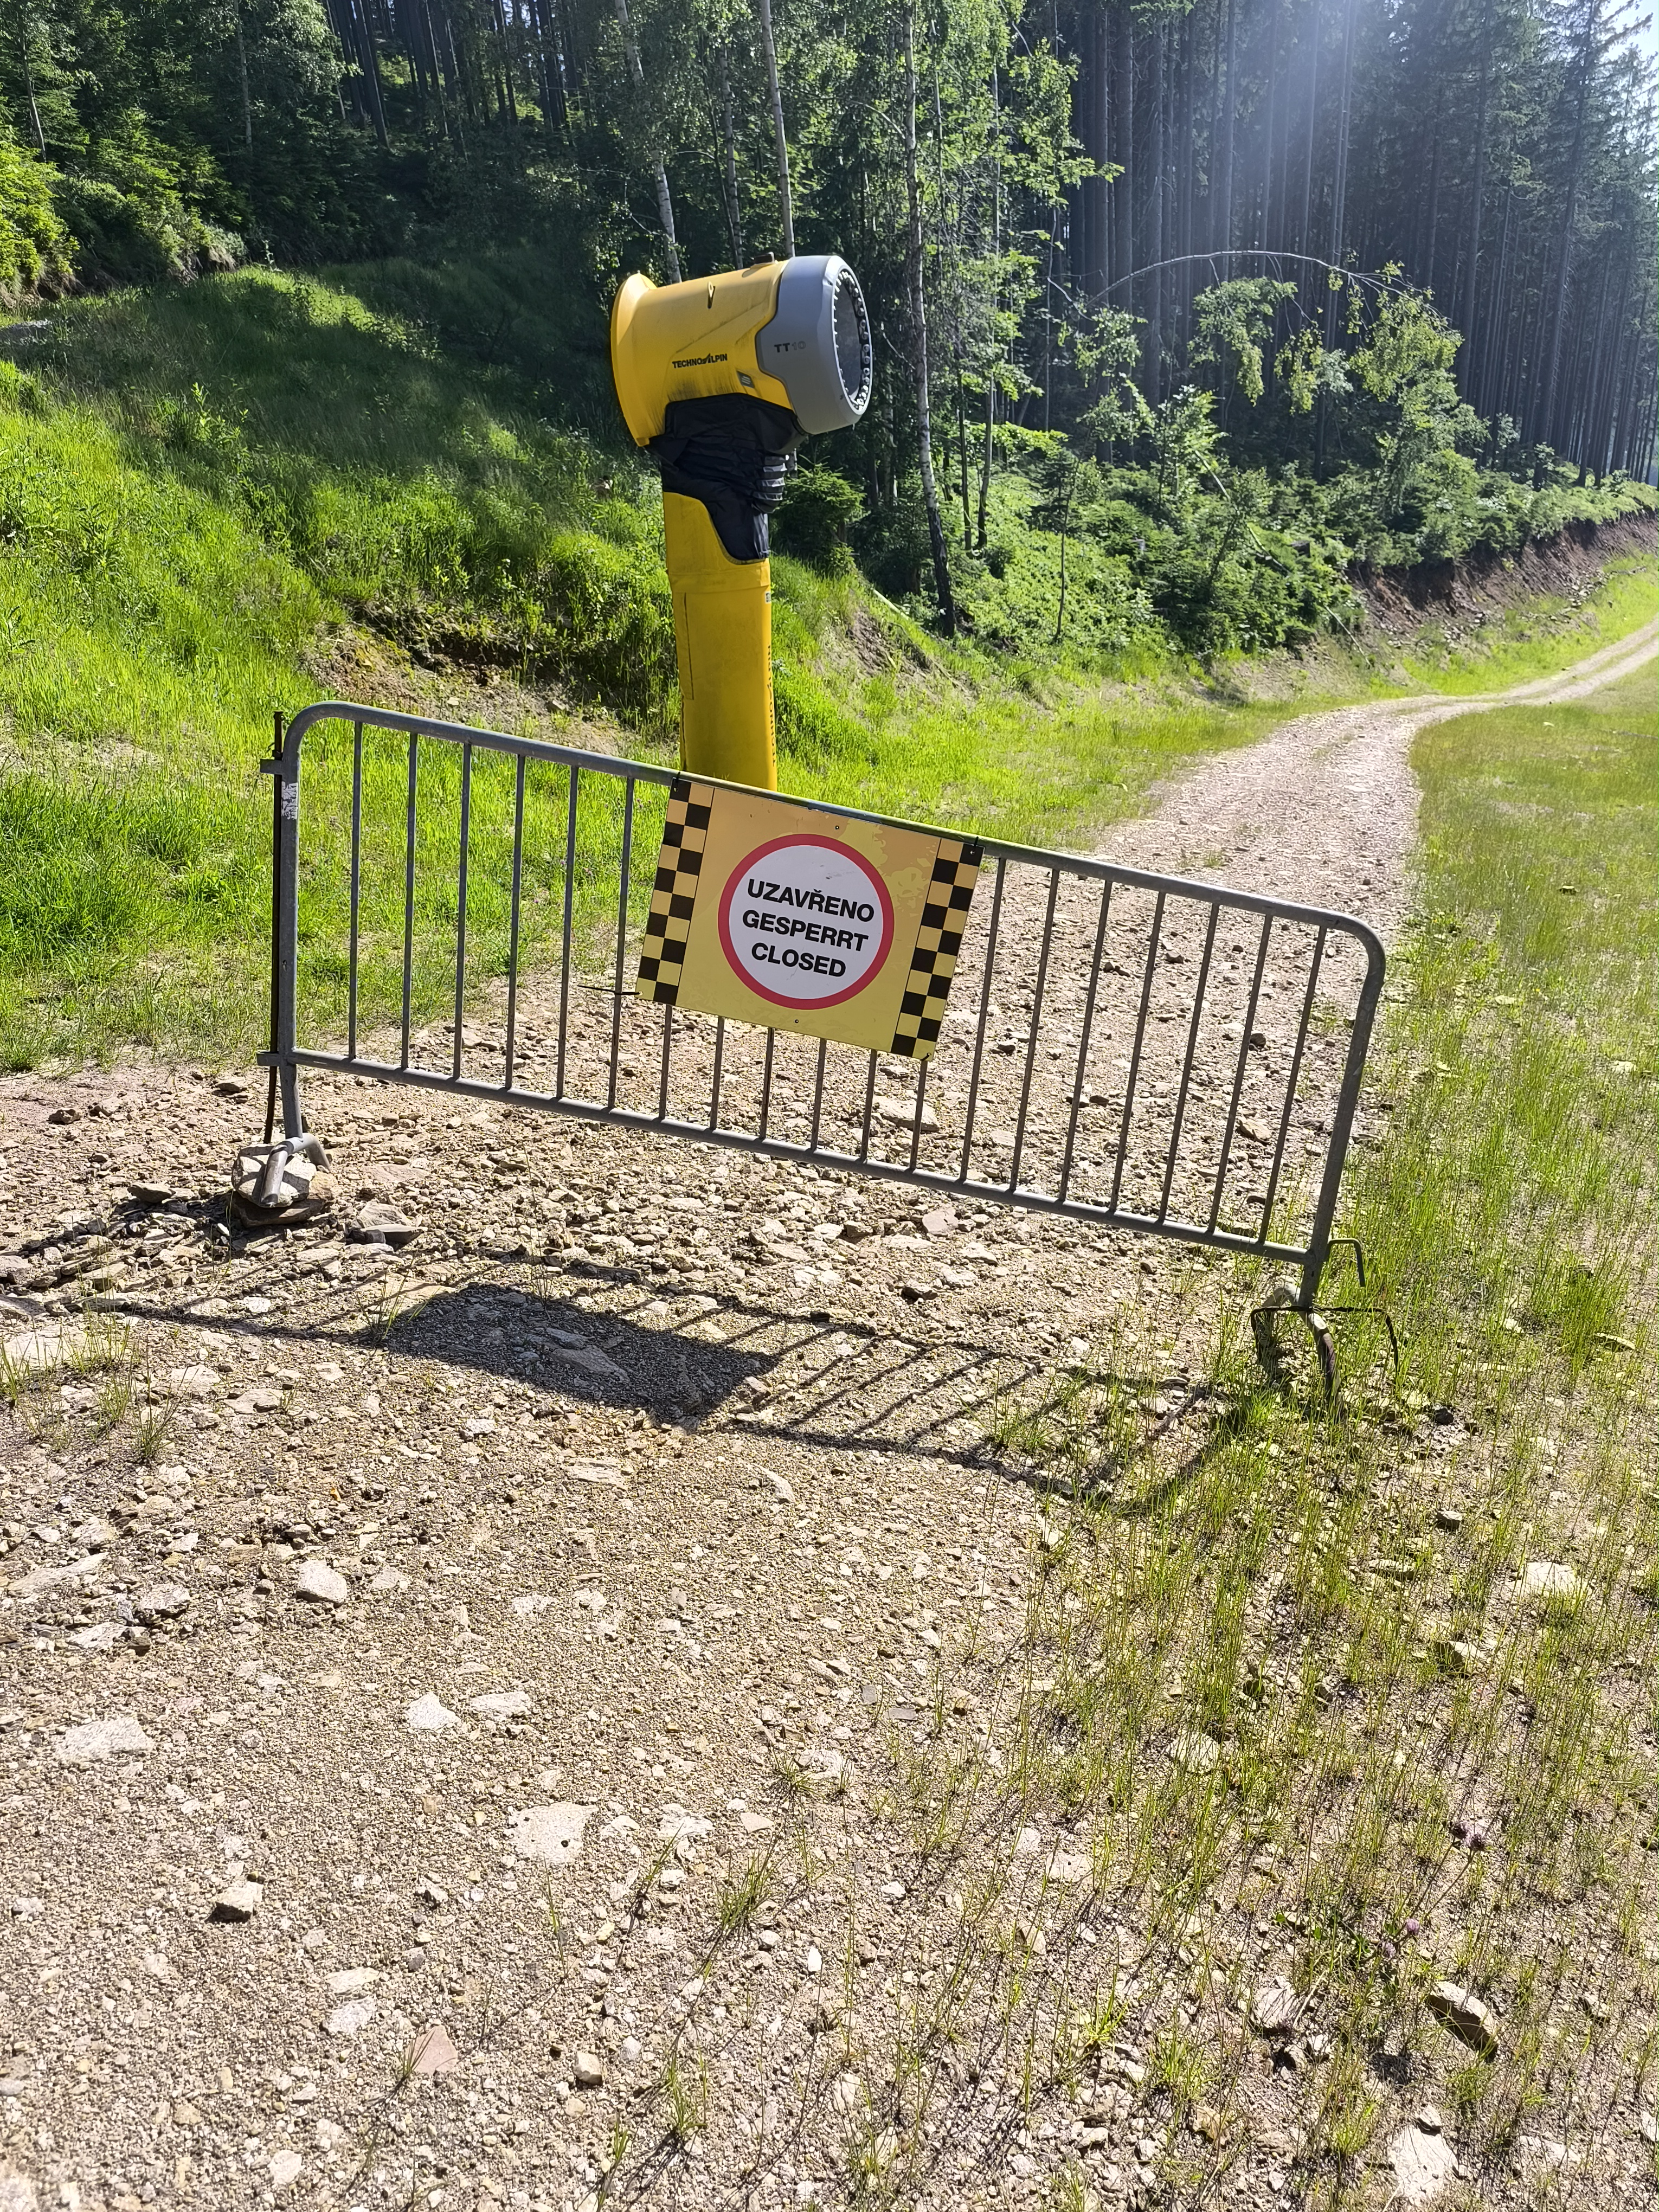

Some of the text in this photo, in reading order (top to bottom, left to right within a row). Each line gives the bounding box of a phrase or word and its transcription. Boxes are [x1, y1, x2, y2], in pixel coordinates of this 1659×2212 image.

[672, 353, 728, 368] TECHNOALPIN
[748, 879, 874, 922] UZAVŘENO
[743, 910, 869, 951] GESPERRT
[751, 942, 846, 977] CLOSED
